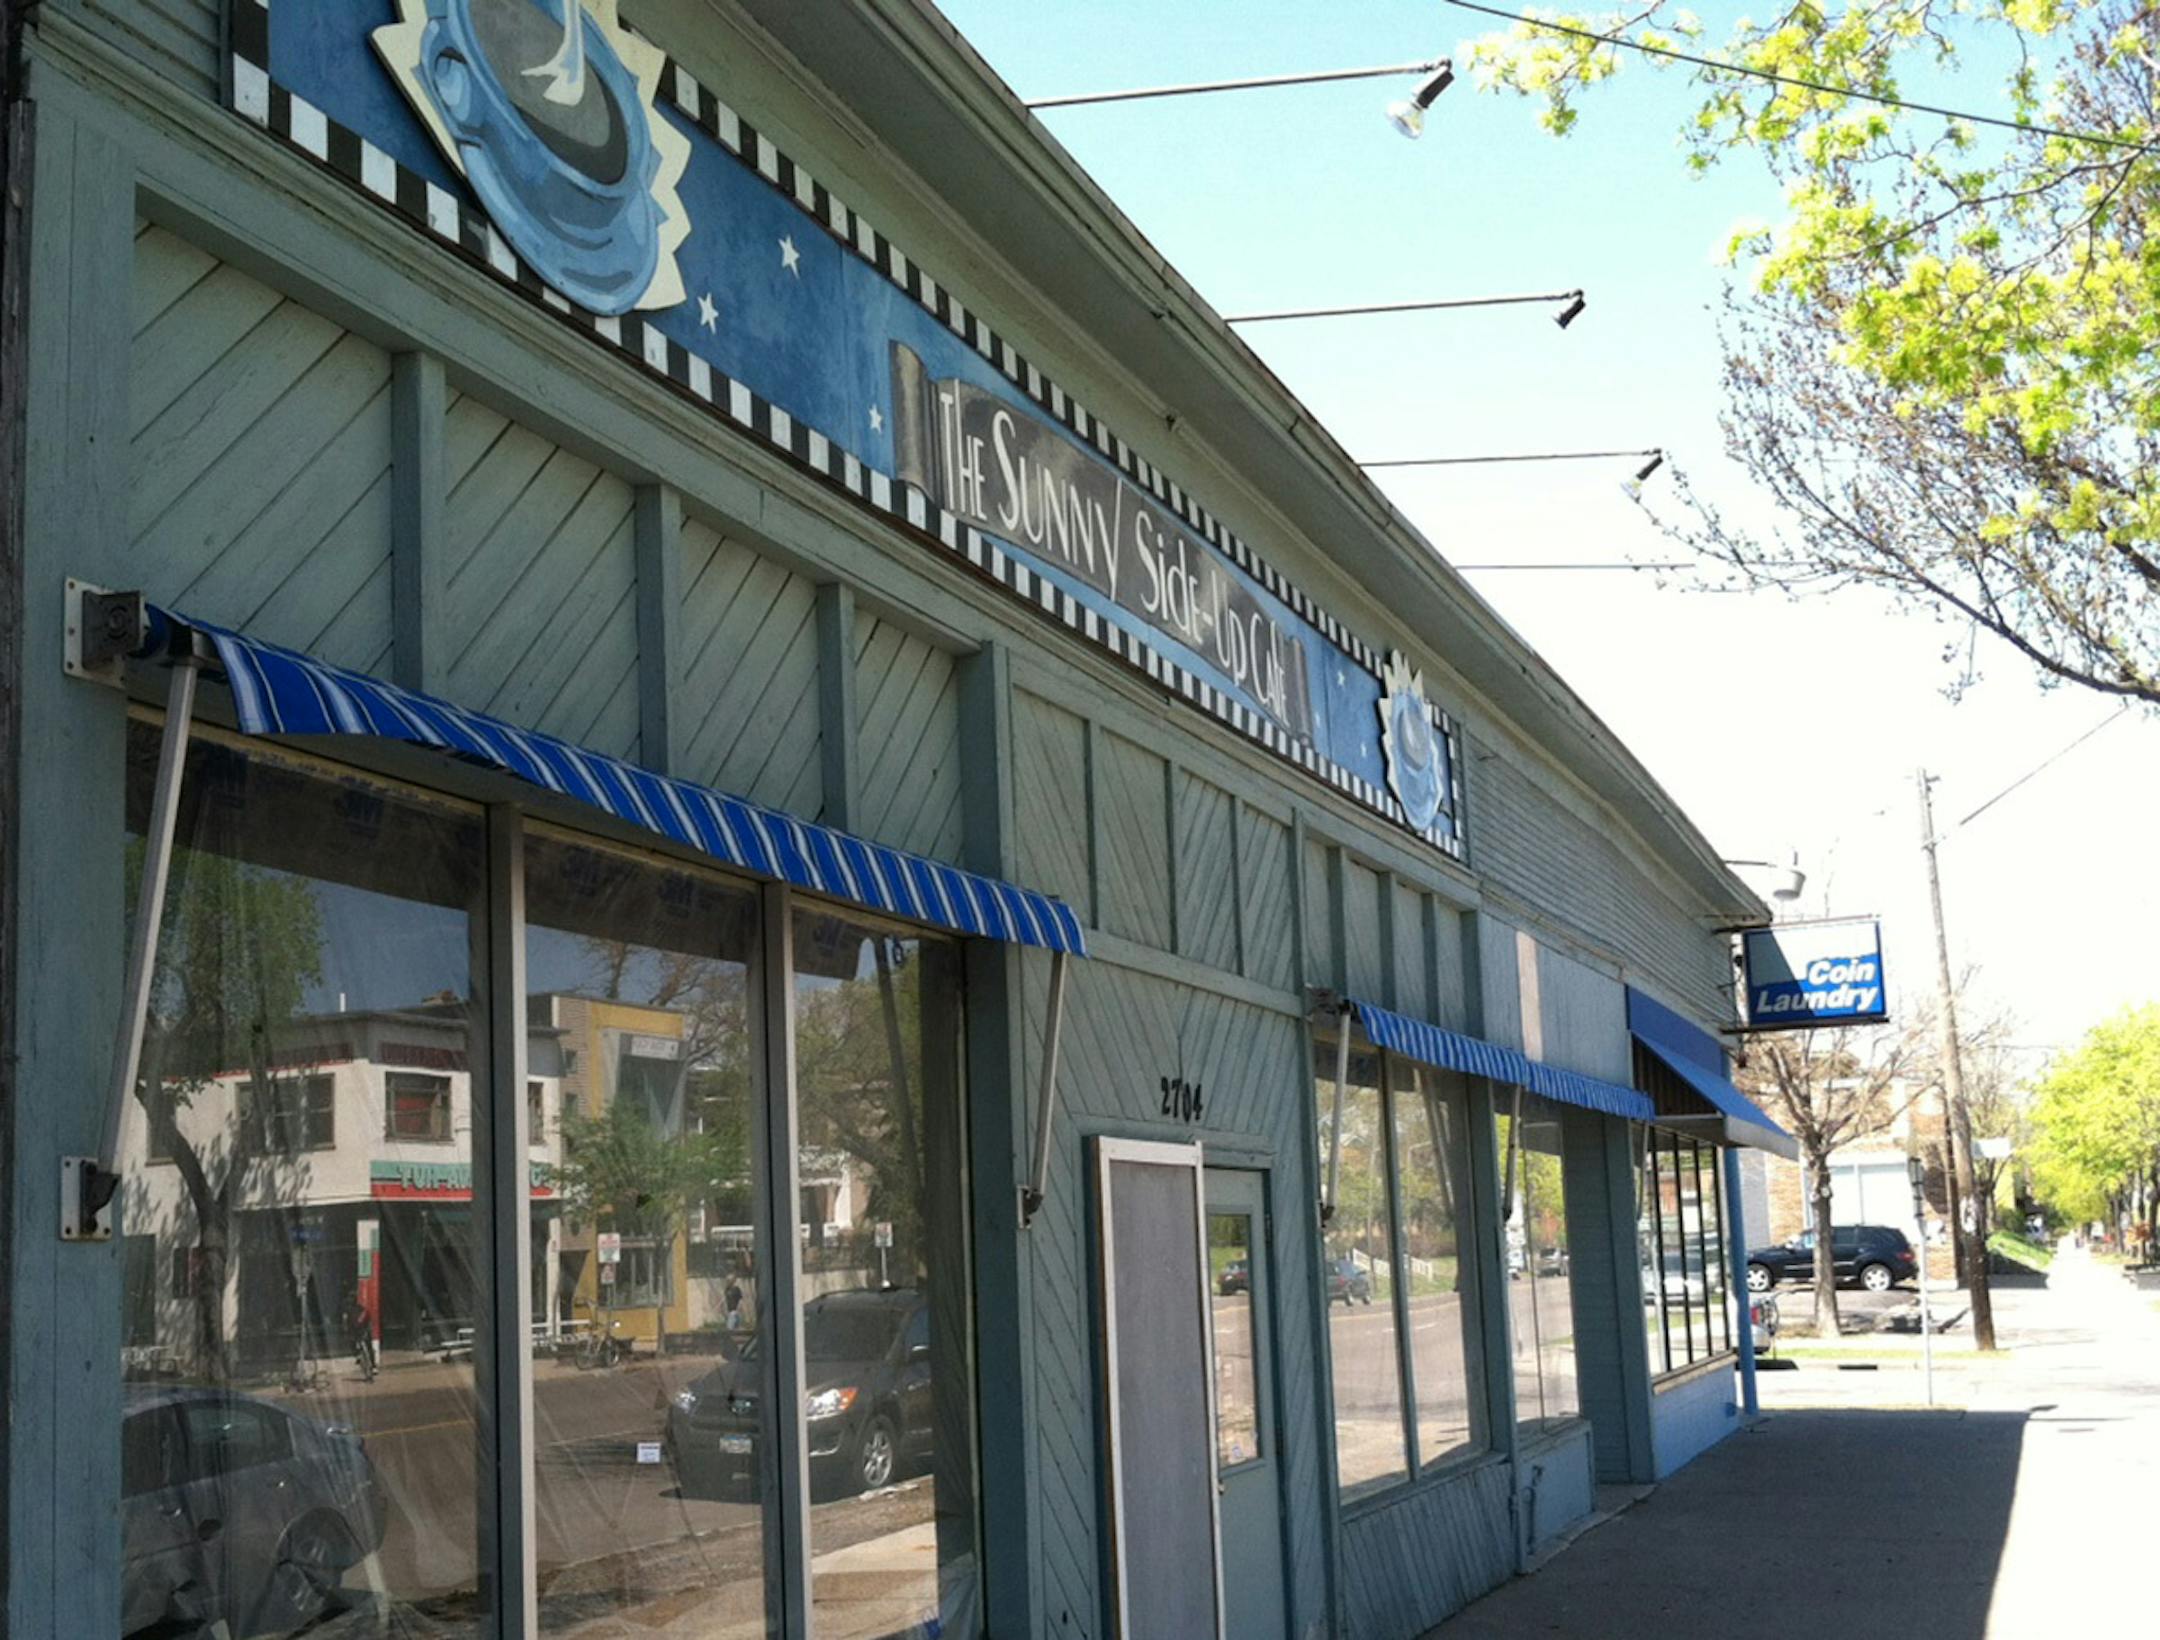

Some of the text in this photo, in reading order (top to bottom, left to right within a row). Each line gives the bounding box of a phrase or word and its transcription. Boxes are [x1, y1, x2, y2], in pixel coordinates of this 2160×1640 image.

[940, 378, 987, 521] THE
[992, 410, 1123, 602] SUNNY
[1250, 612, 1291, 727] CAFE
[1807, 958, 1876, 986] Coin
[1756, 984, 1878, 1013] Laundry
[1161, 1077, 1203, 1122] 2704
